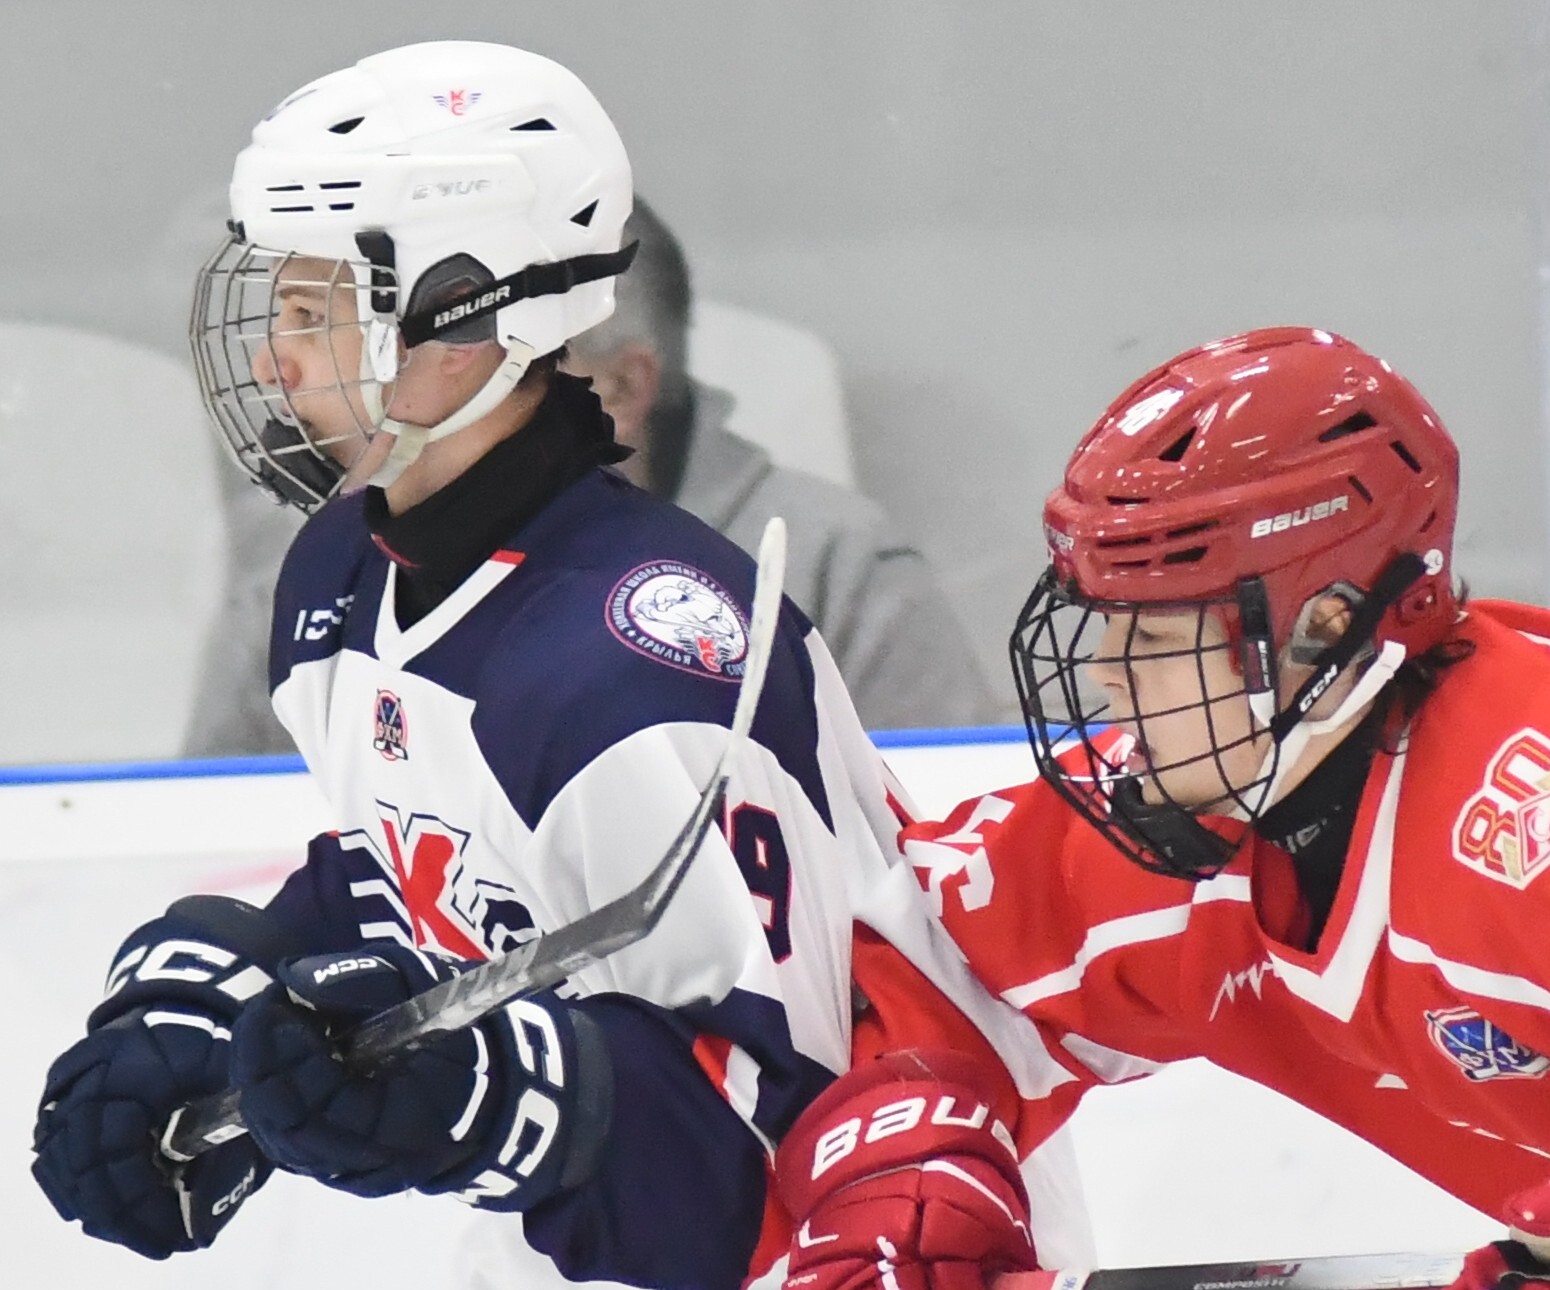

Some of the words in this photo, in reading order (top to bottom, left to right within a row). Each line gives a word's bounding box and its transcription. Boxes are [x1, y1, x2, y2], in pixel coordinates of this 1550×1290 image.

[434, 284, 511, 329] BAUER
[1250, 494, 1350, 539] BAUER
[714, 794, 792, 965] 9
[313, 957, 378, 985] CCM
